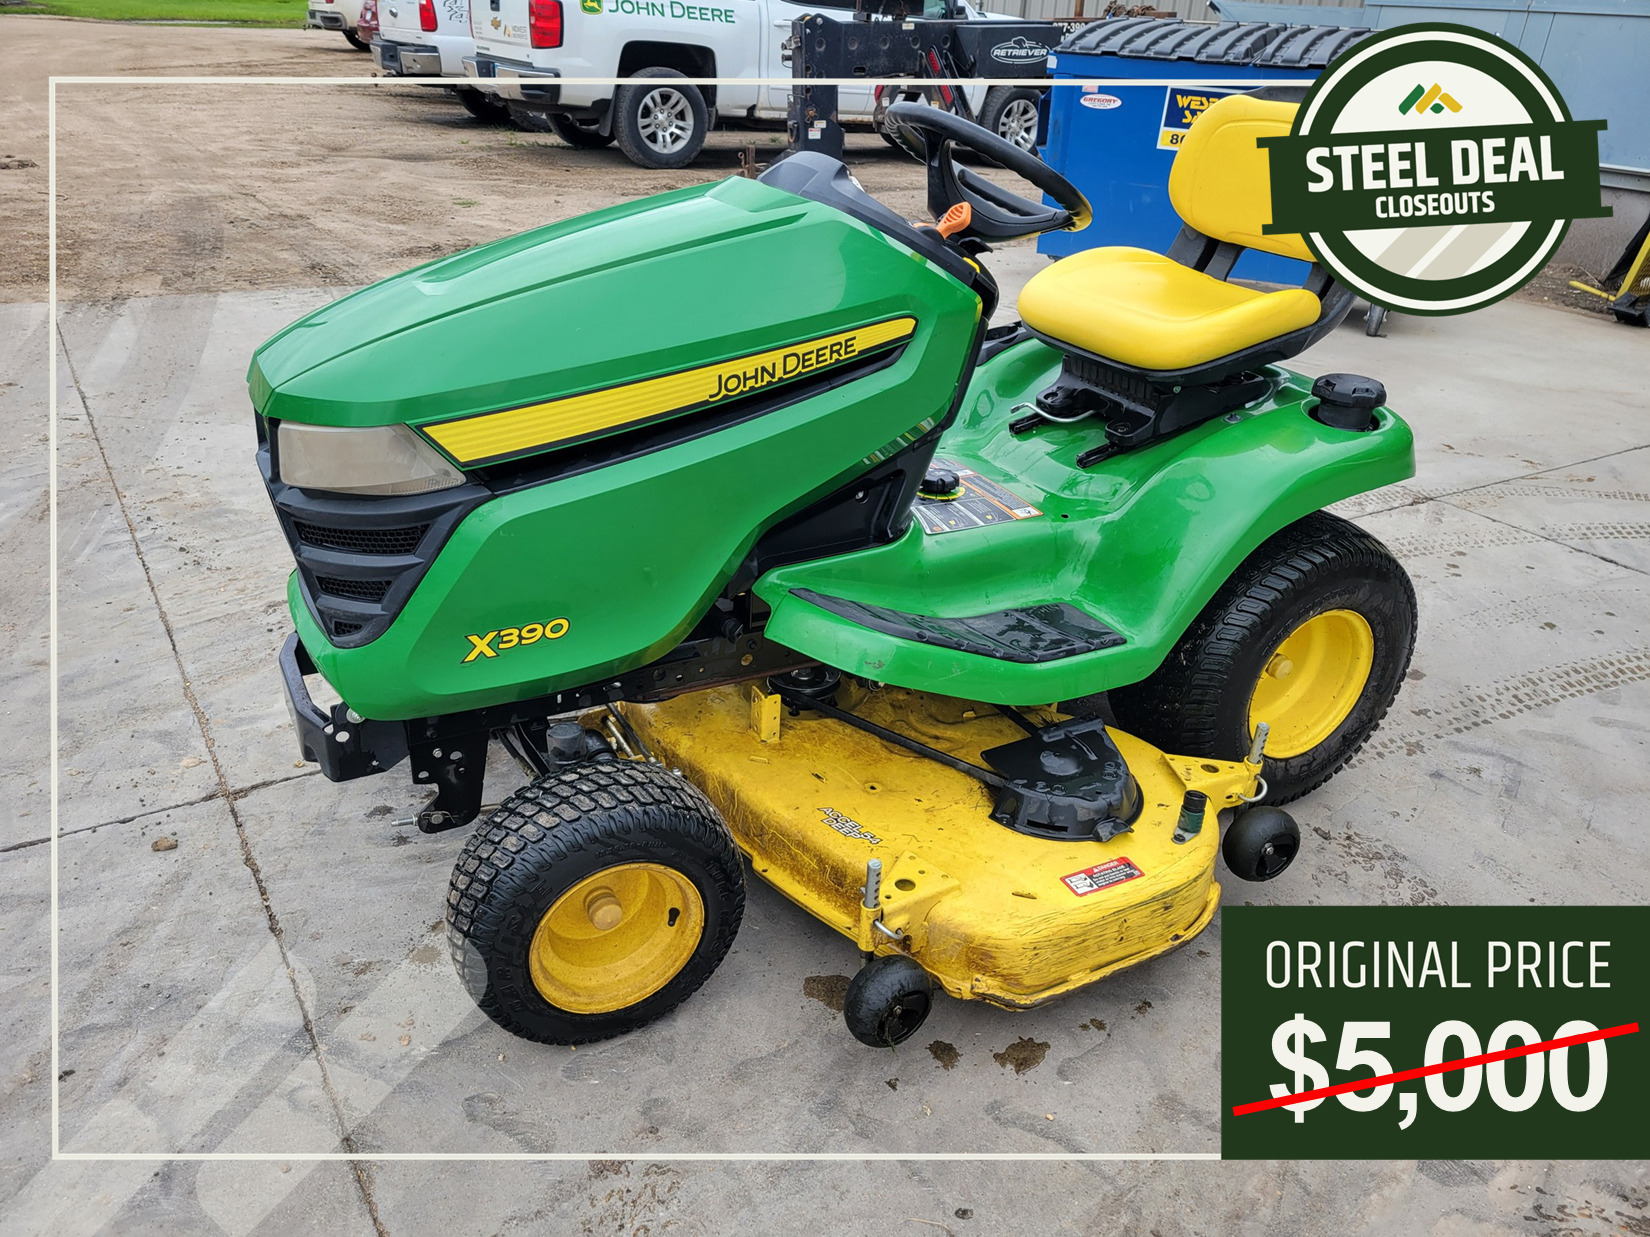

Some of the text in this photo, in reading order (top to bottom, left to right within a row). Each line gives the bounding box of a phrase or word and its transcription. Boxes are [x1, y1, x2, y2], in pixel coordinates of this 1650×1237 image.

[609, 0, 736, 24] JOHN DEERE
[993, 48, 1048, 57] RETRIEVER
[708, 335, 857, 400] JOHN DEERE
[460, 617, 570, 664] X390
[816, 807, 883, 845] ACCEL 54
[821, 817, 862, 839] DEEP
